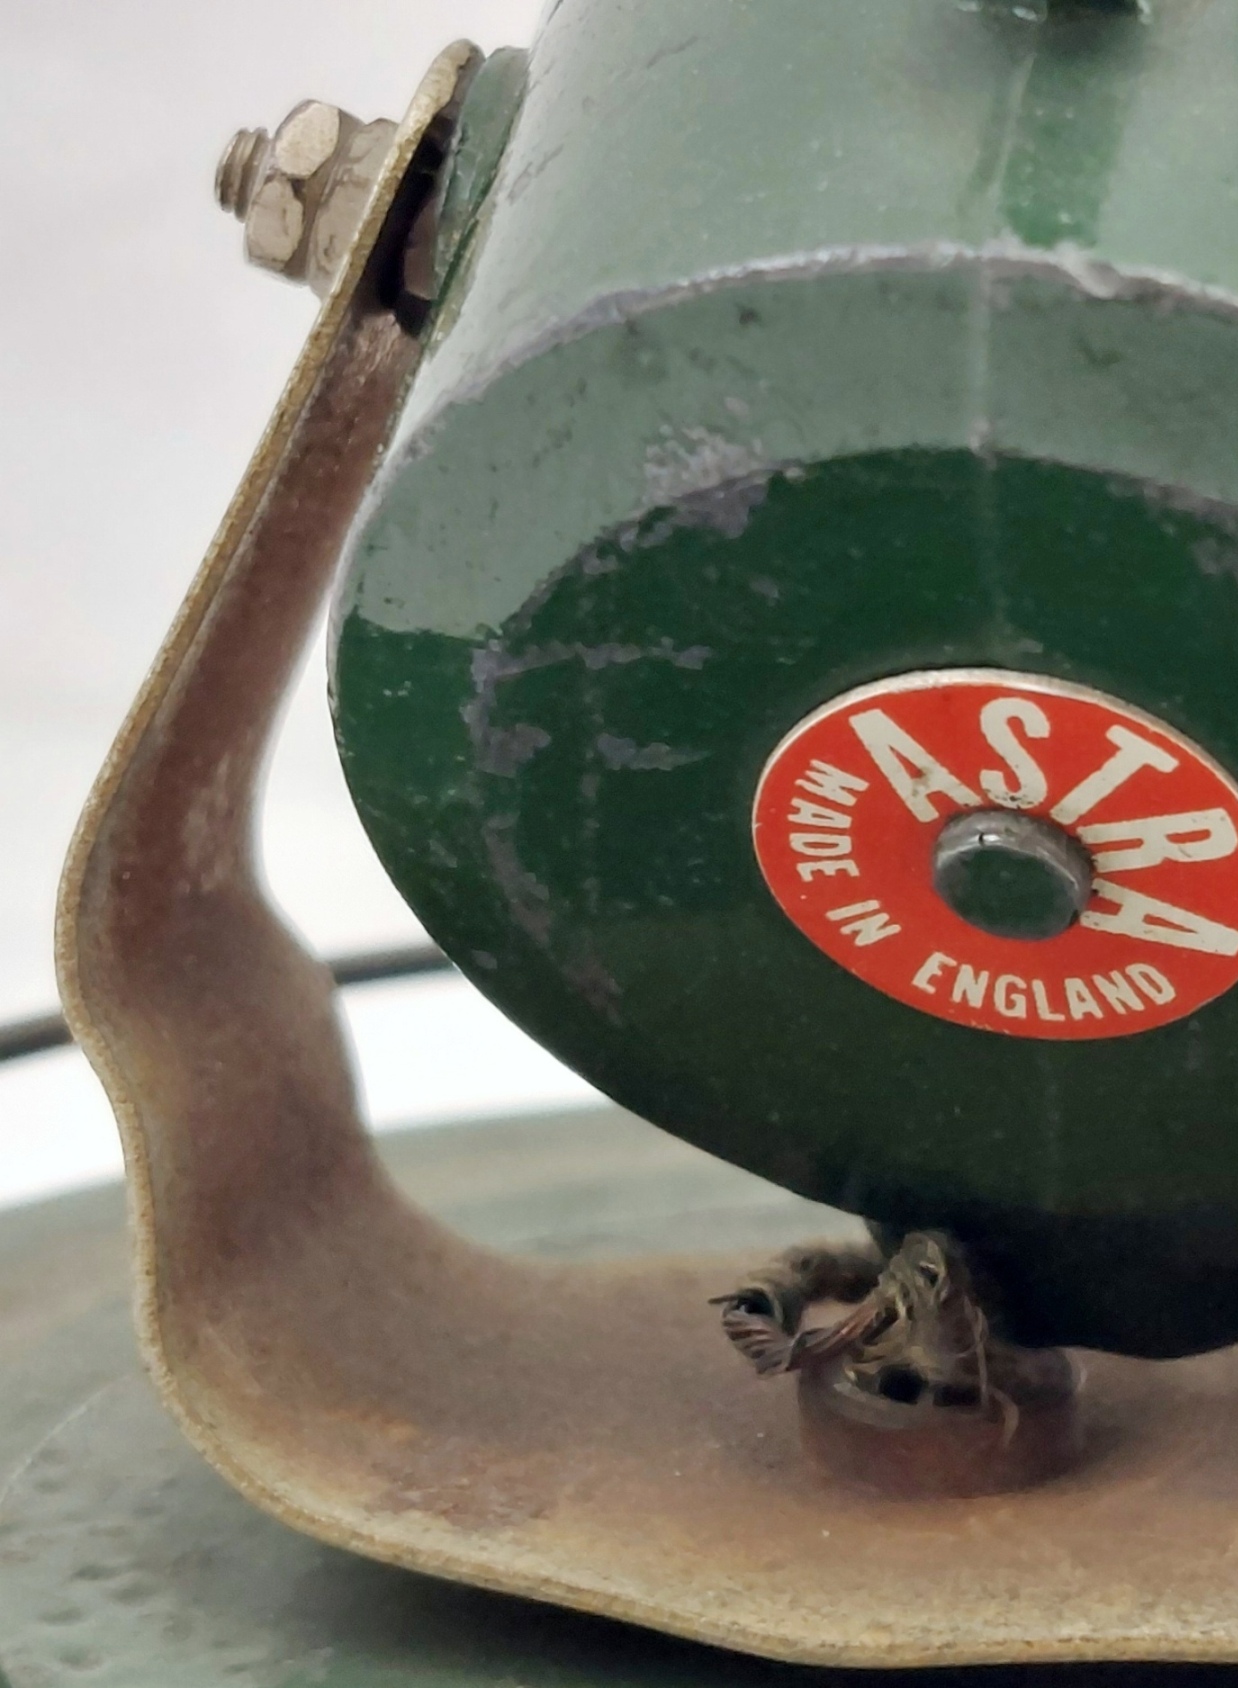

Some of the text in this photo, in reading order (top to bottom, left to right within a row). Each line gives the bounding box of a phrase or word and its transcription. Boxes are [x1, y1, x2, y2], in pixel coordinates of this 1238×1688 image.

[787, 759, 1176, 1022] MADE IN ENGLAND
